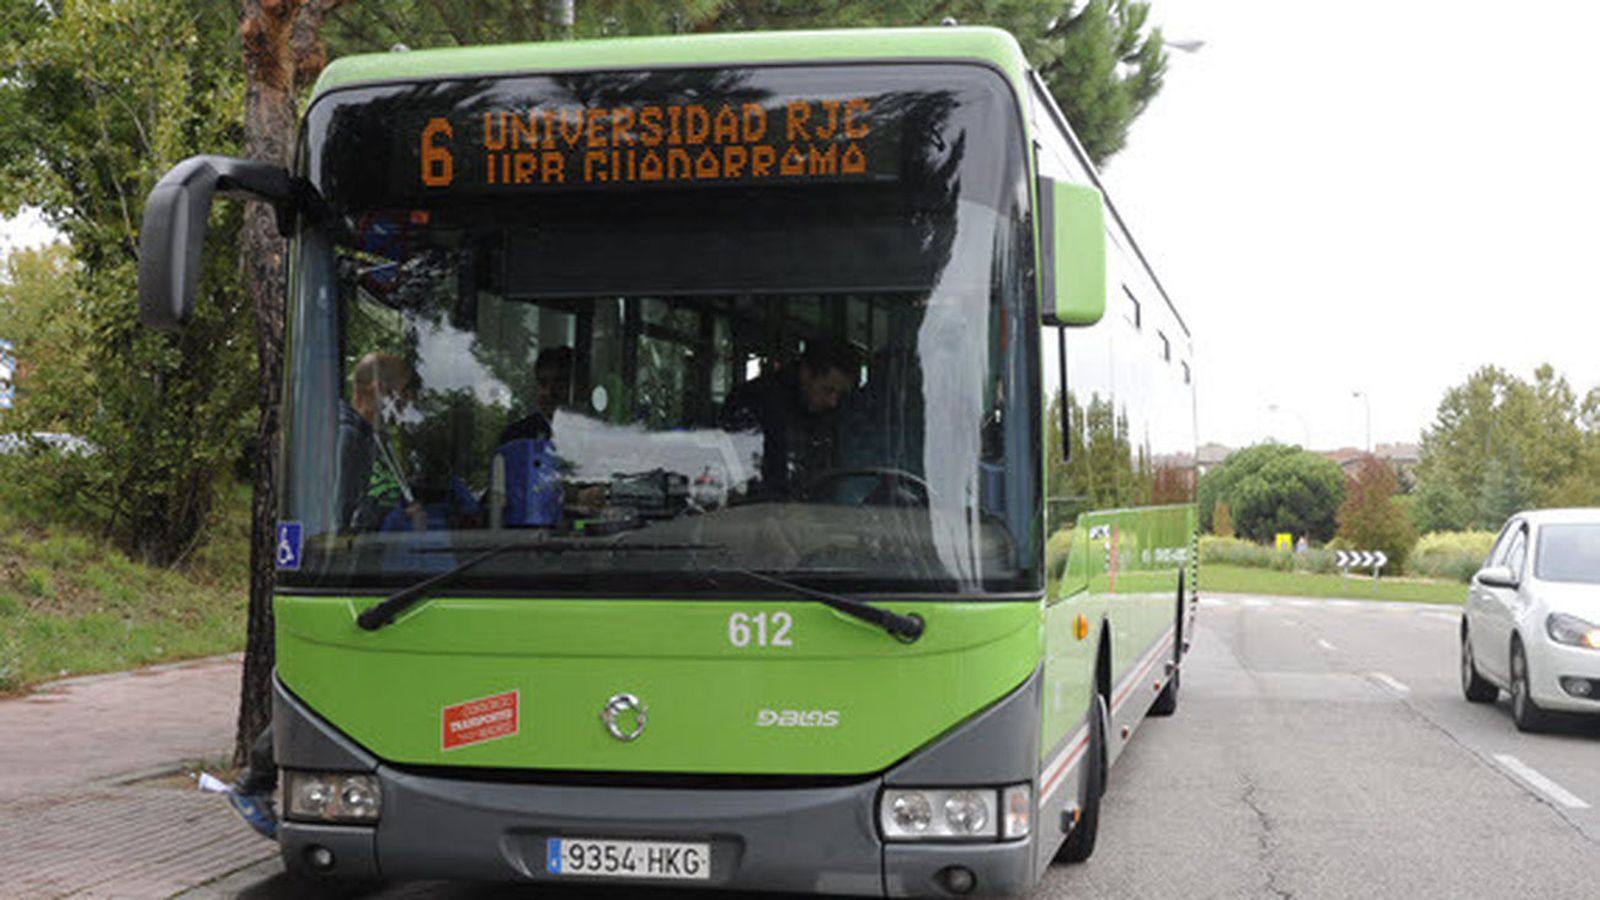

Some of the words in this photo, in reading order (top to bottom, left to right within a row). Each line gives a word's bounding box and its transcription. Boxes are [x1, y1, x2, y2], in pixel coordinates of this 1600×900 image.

[483, 102, 768, 150] UNIVERSIDAD
[786, 98, 871, 141] RJC
[420, 116, 454, 187] 6
[727, 610, 793, 648] 612
